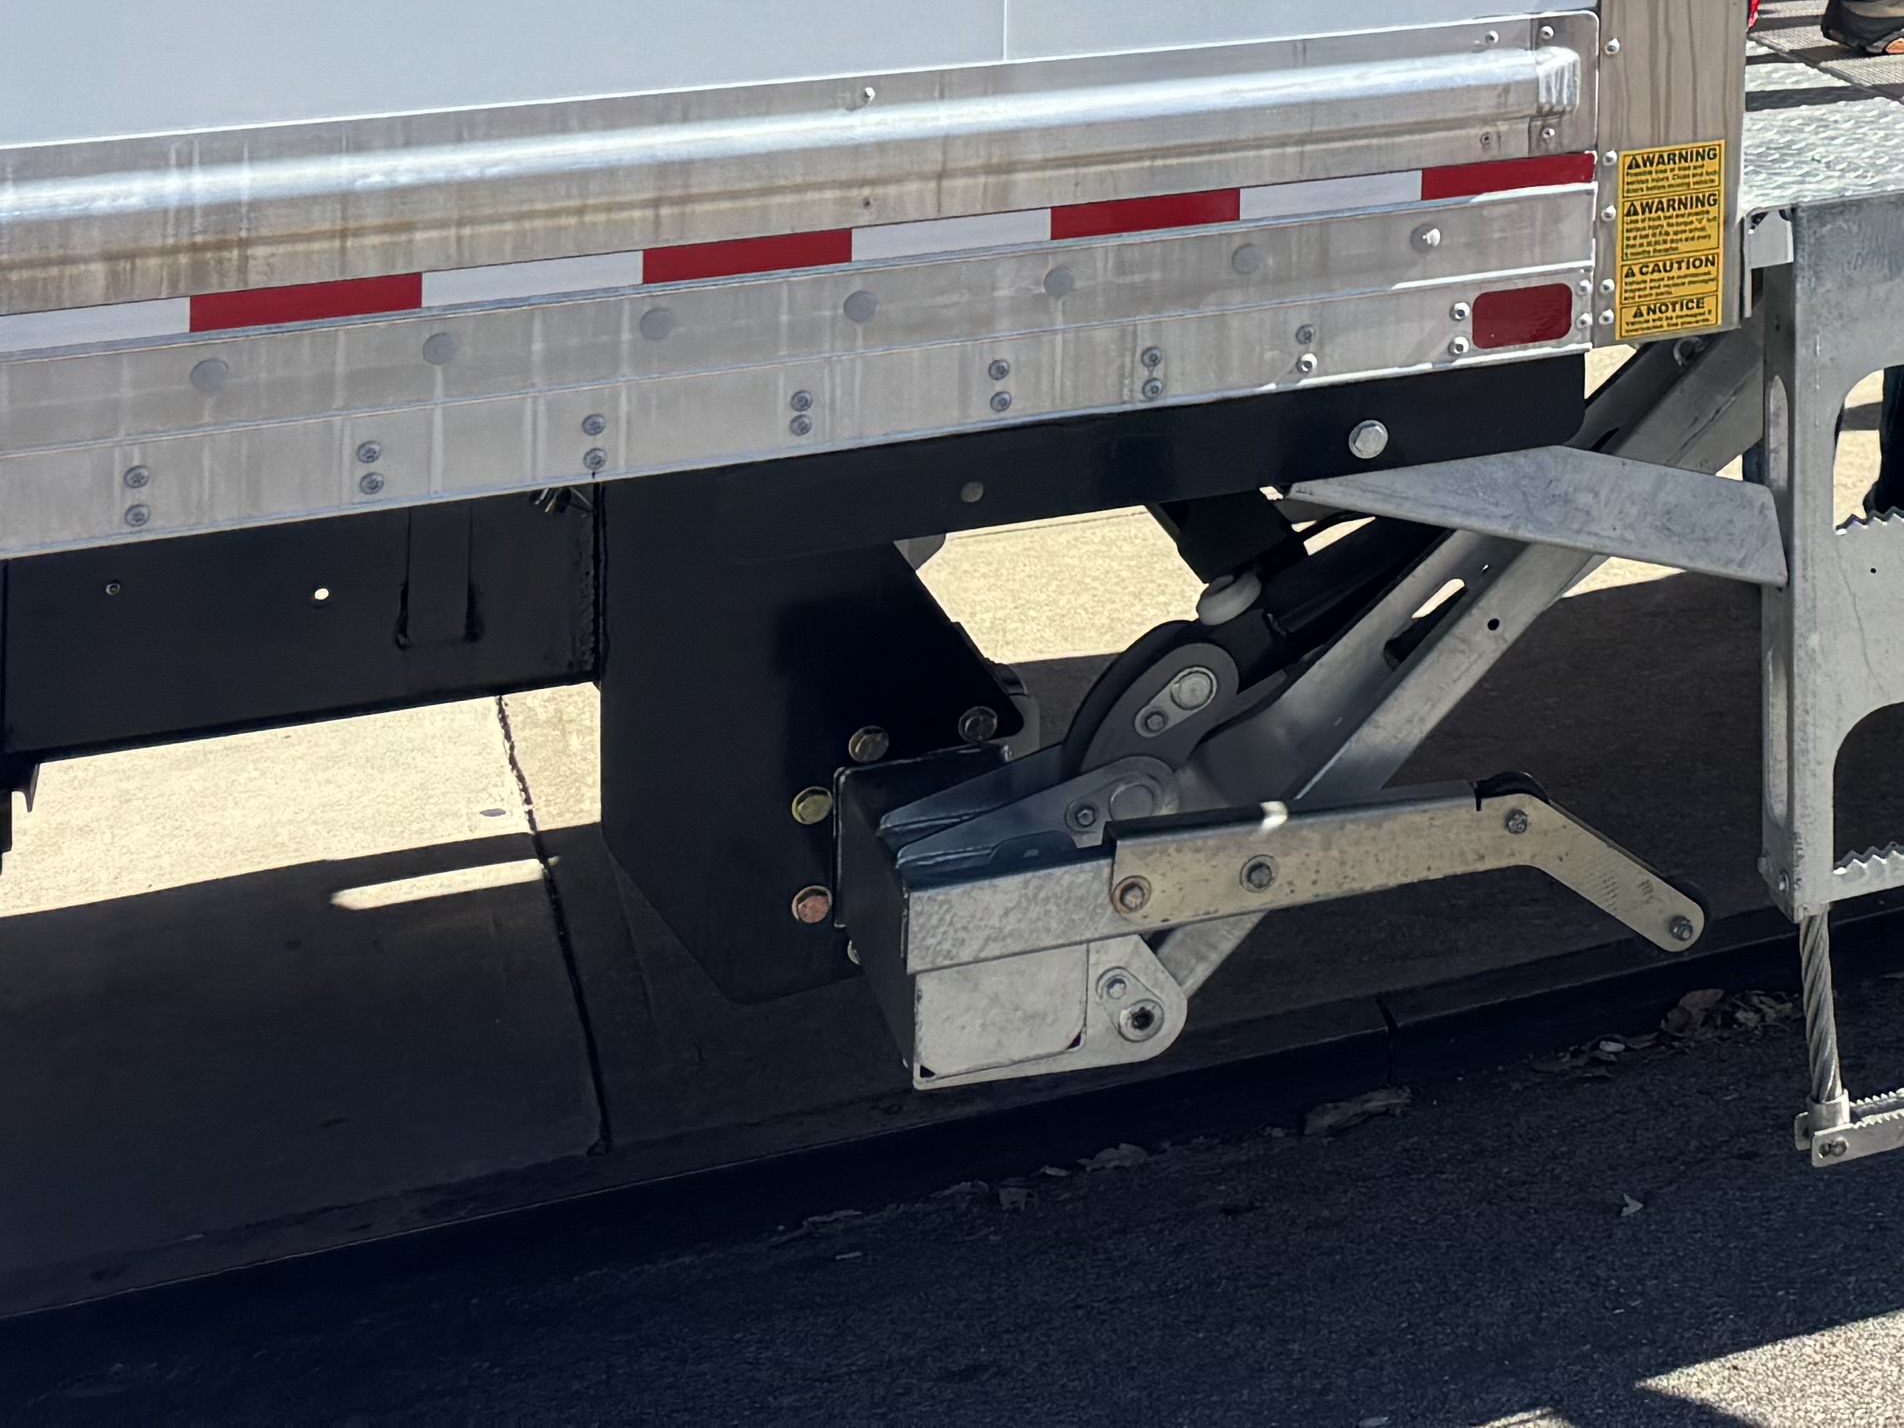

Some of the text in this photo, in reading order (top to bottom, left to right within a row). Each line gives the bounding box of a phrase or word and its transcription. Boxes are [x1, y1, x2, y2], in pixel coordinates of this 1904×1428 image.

[1641, 147, 1718, 168] WARNING
[1640, 193, 1718, 216] WARNING
[1639, 255, 1716, 276] CAUTION
[1646, 297, 1705, 316] NOTICE
